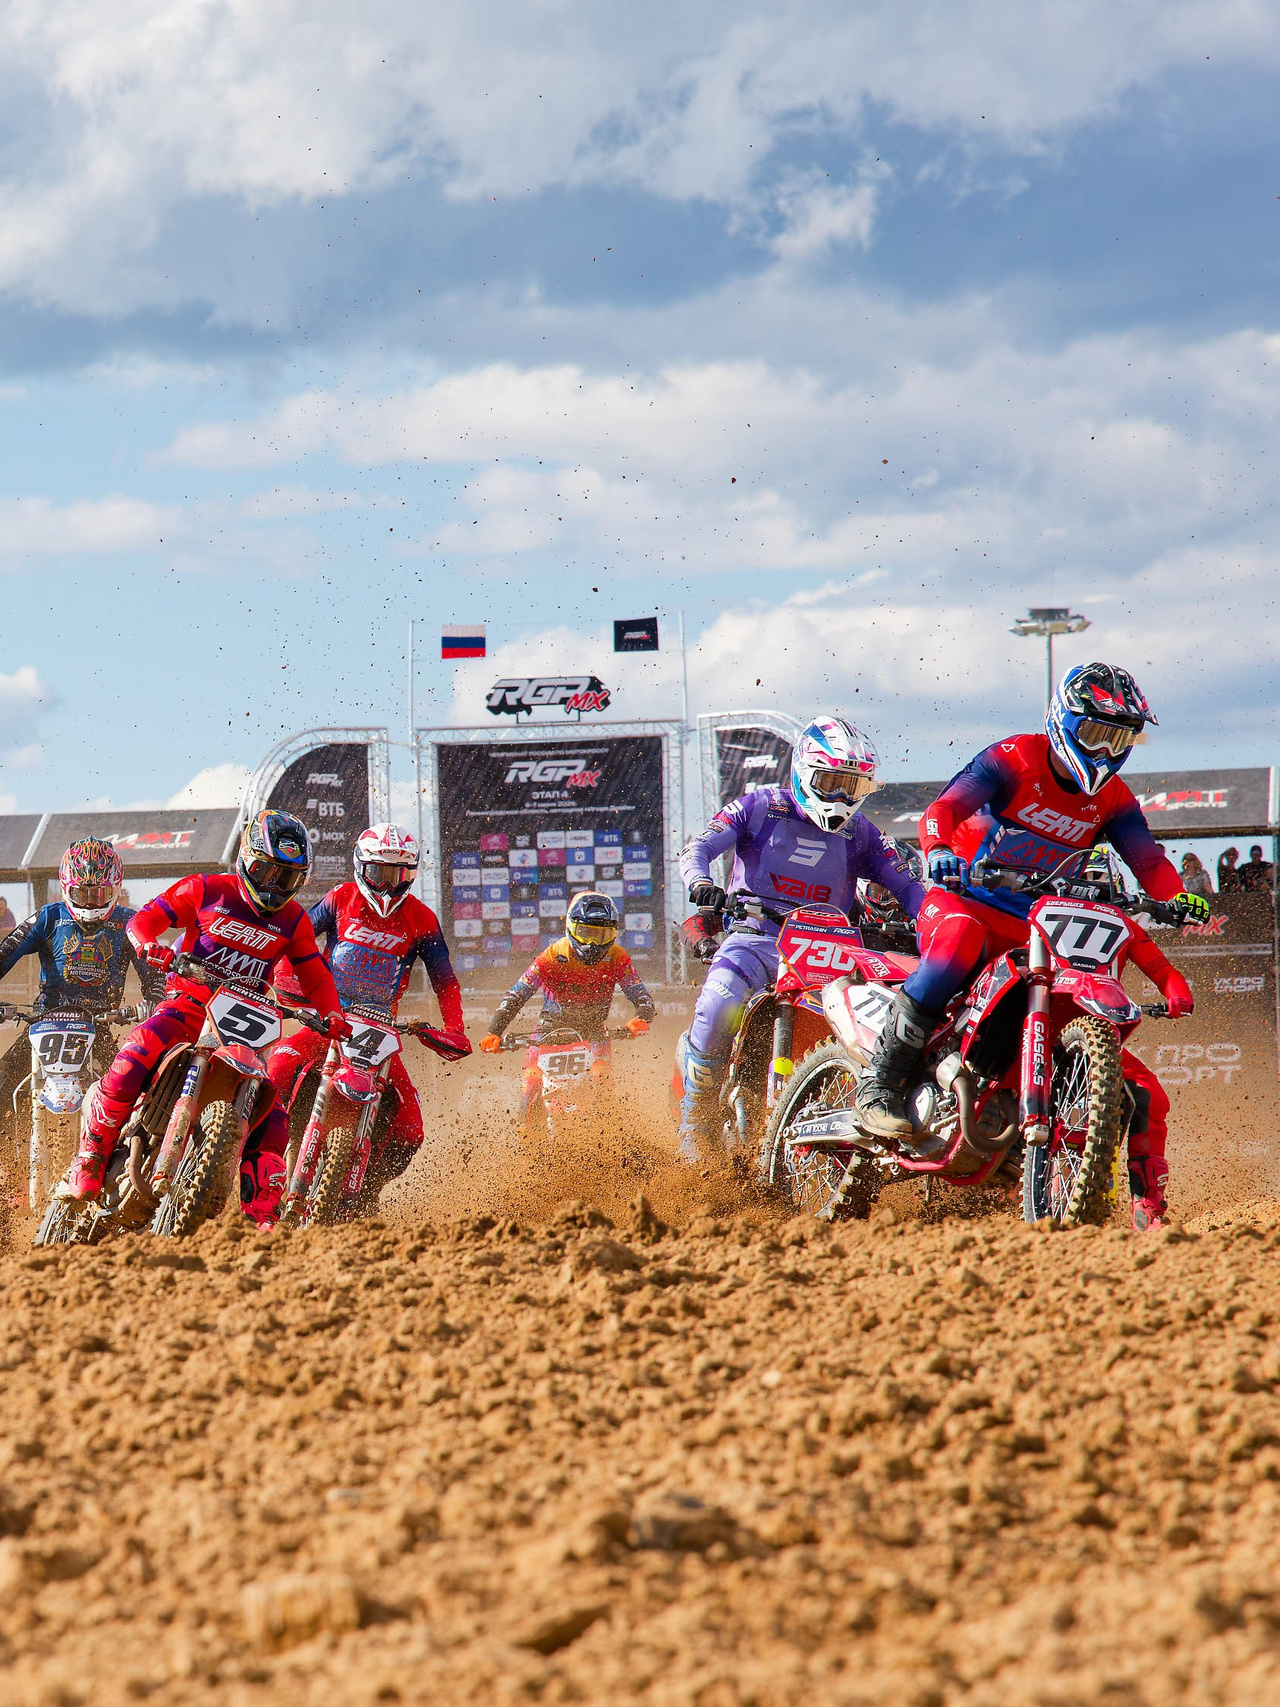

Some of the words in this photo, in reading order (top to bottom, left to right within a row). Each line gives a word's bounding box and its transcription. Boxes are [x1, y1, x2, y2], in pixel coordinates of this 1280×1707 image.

[488, 676, 592, 706] RGP
[565, 690, 610, 711] MX
[504, 759, 586, 783] RGP
[566, 770, 601, 788] MX
[318, 801, 346, 817] ВТБ
[532, 790, 559, 800] ЭТАП
[1017, 802, 1097, 843] LEATT
[769, 873, 832, 903] VB18
[208, 916, 277, 950] LEATT
[343, 923, 404, 950] LEATT
[833, 927, 856, 936] RGP
[1044, 913, 1124, 955] 777
[788, 937, 856, 971] 730
[230, 985, 273, 1005] RENTHAL
[218, 1003, 276, 1041] 5
[38, 1034, 89, 1066] 95
[346, 1028, 388, 1058] 4
[1155, 1043, 1242, 1063] ПРО
[548, 1053, 585, 1076] 96
[1156, 1065, 1242, 1084] ОРТ
[301, 1128, 320, 1174] GASGS
